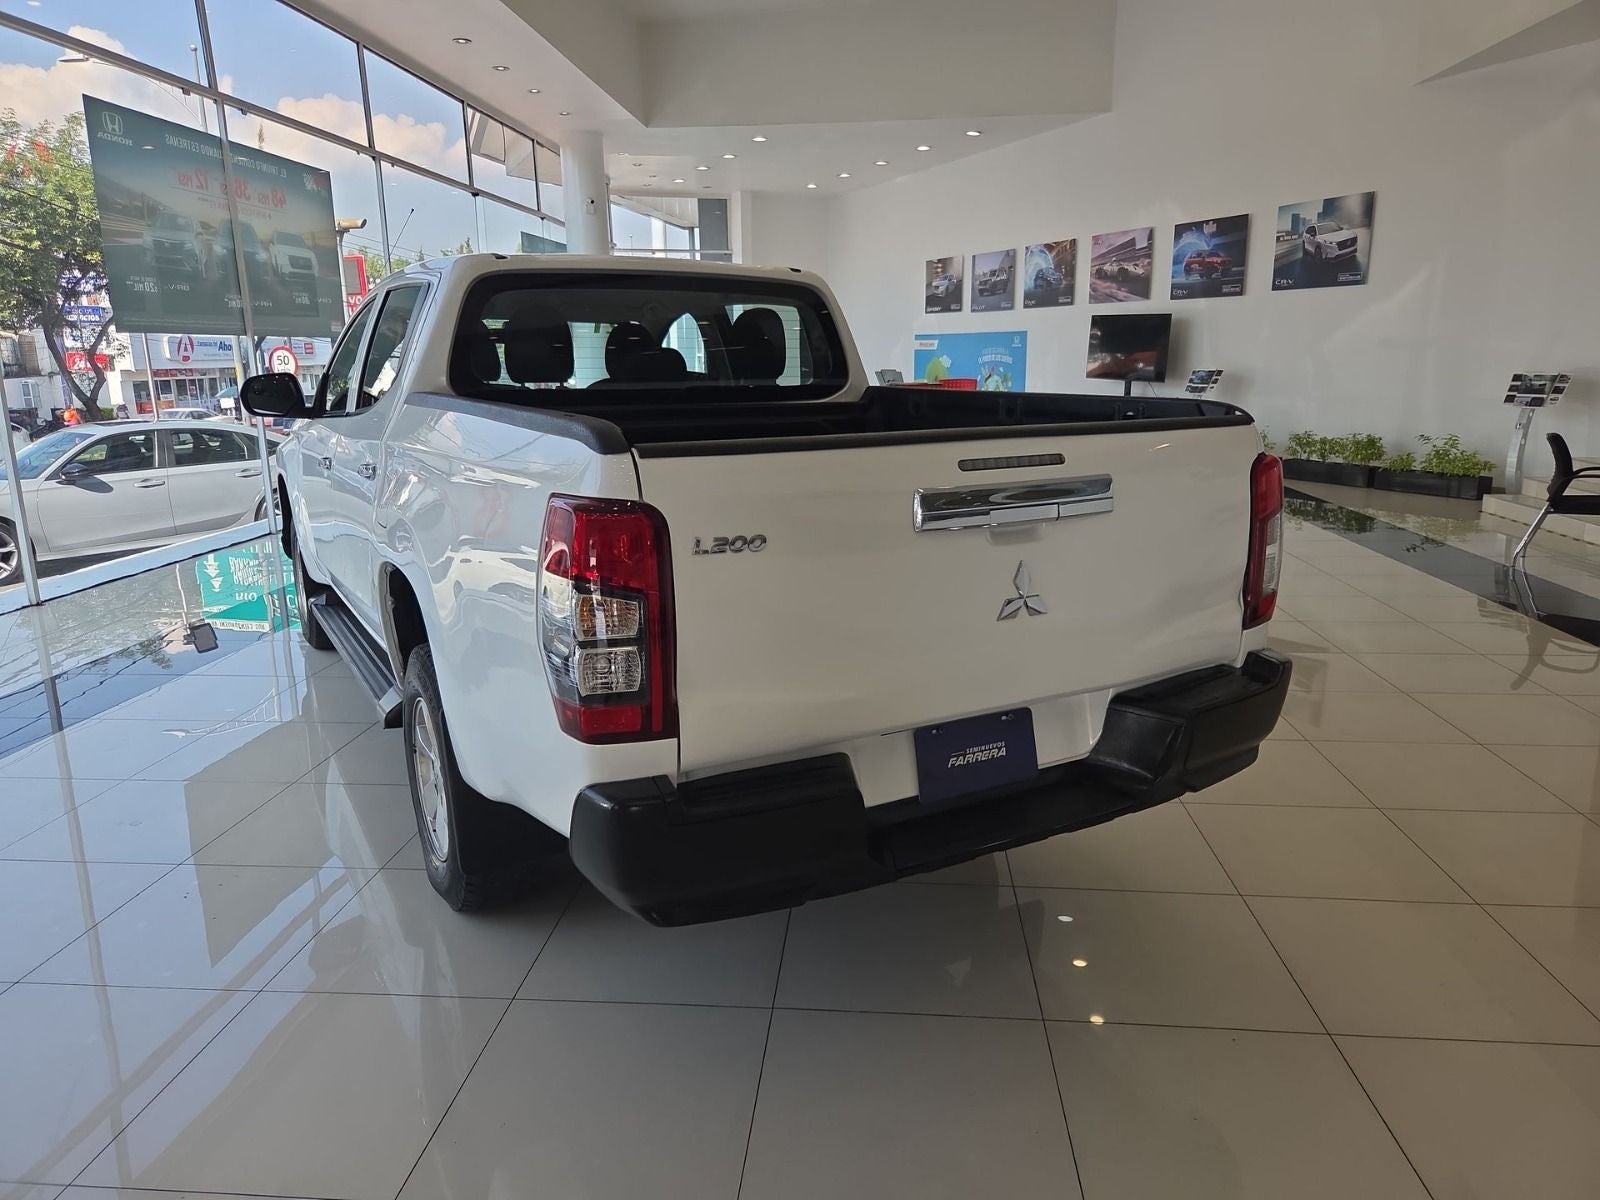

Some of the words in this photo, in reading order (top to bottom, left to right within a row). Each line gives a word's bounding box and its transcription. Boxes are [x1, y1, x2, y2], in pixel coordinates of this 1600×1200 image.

[277, 355, 290, 366] 50
[692, 534, 767, 556] L200
[966, 741, 1006, 754] SEMINUEVOS
[947, 747, 1007, 769] FARRERA
